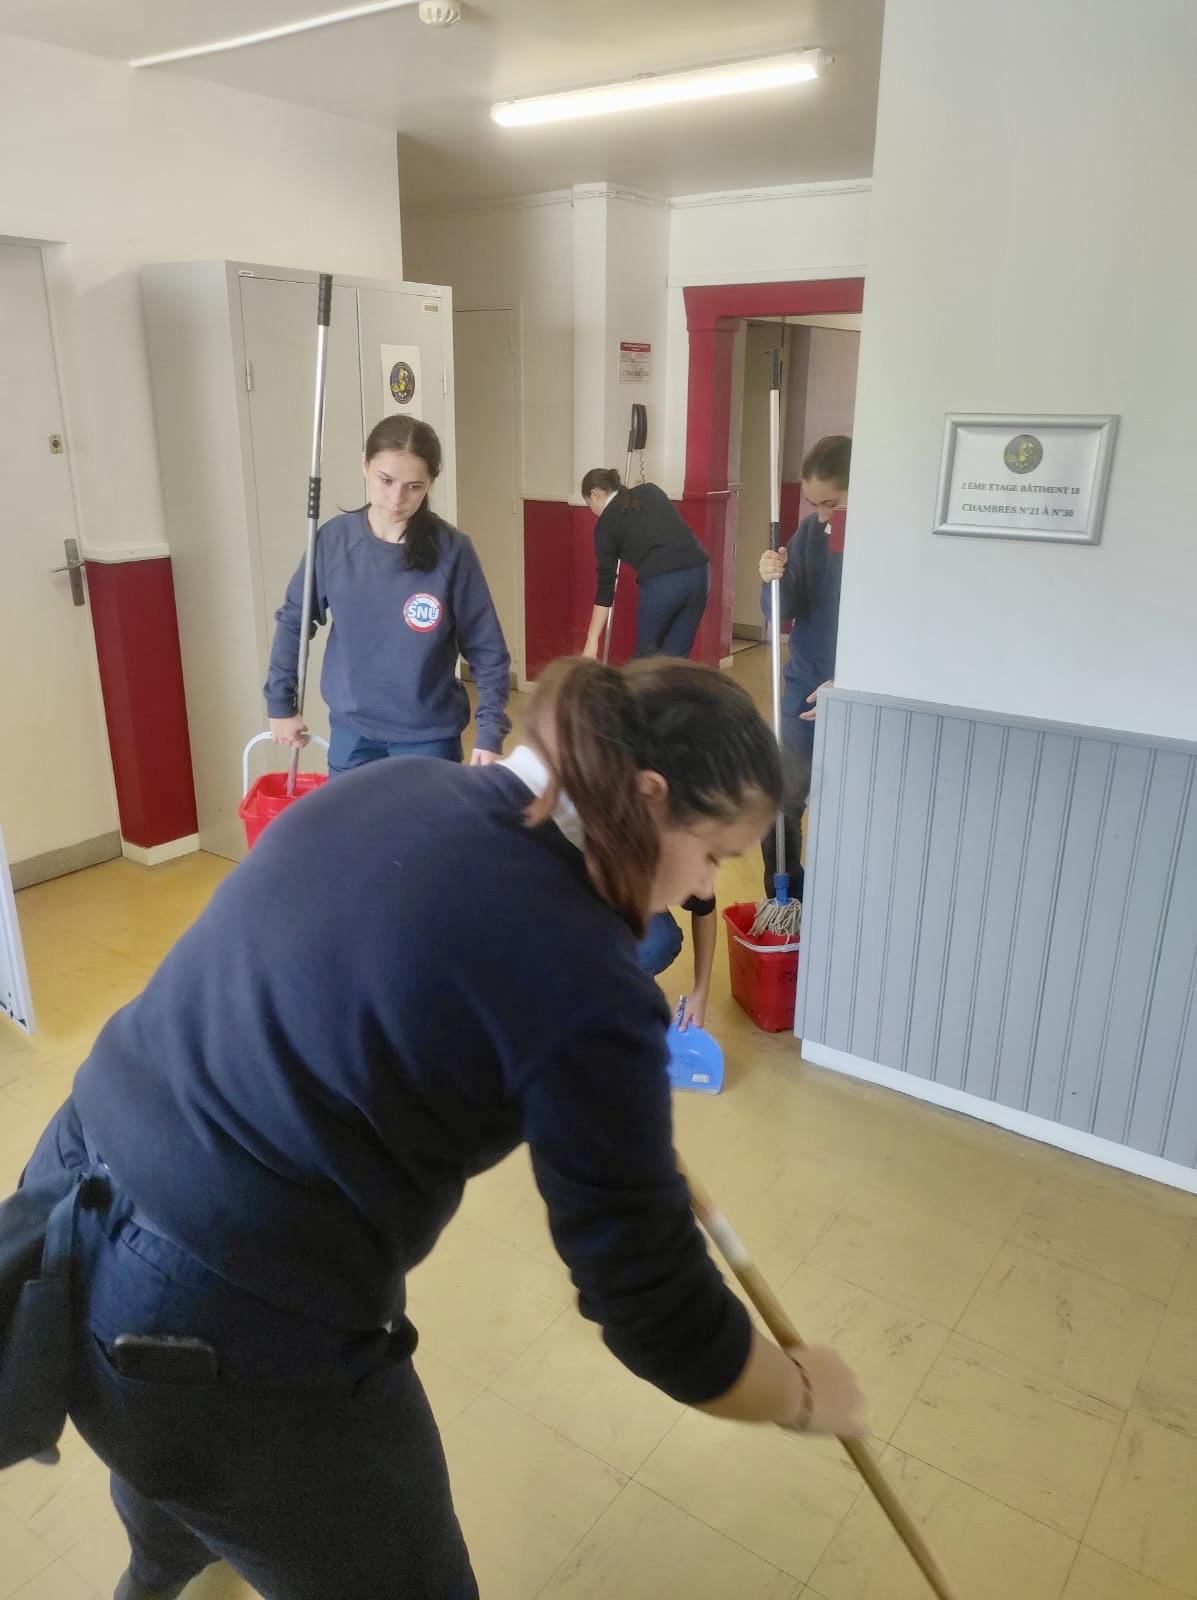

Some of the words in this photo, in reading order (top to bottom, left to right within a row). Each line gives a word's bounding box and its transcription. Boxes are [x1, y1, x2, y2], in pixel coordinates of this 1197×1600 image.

[1020, 483, 1069, 495] BÂTIMENT
[962, 503, 1017, 514] CHAMBRES
[1041, 505, 1049, 516] À
[408, 606, 440, 620] SNU
